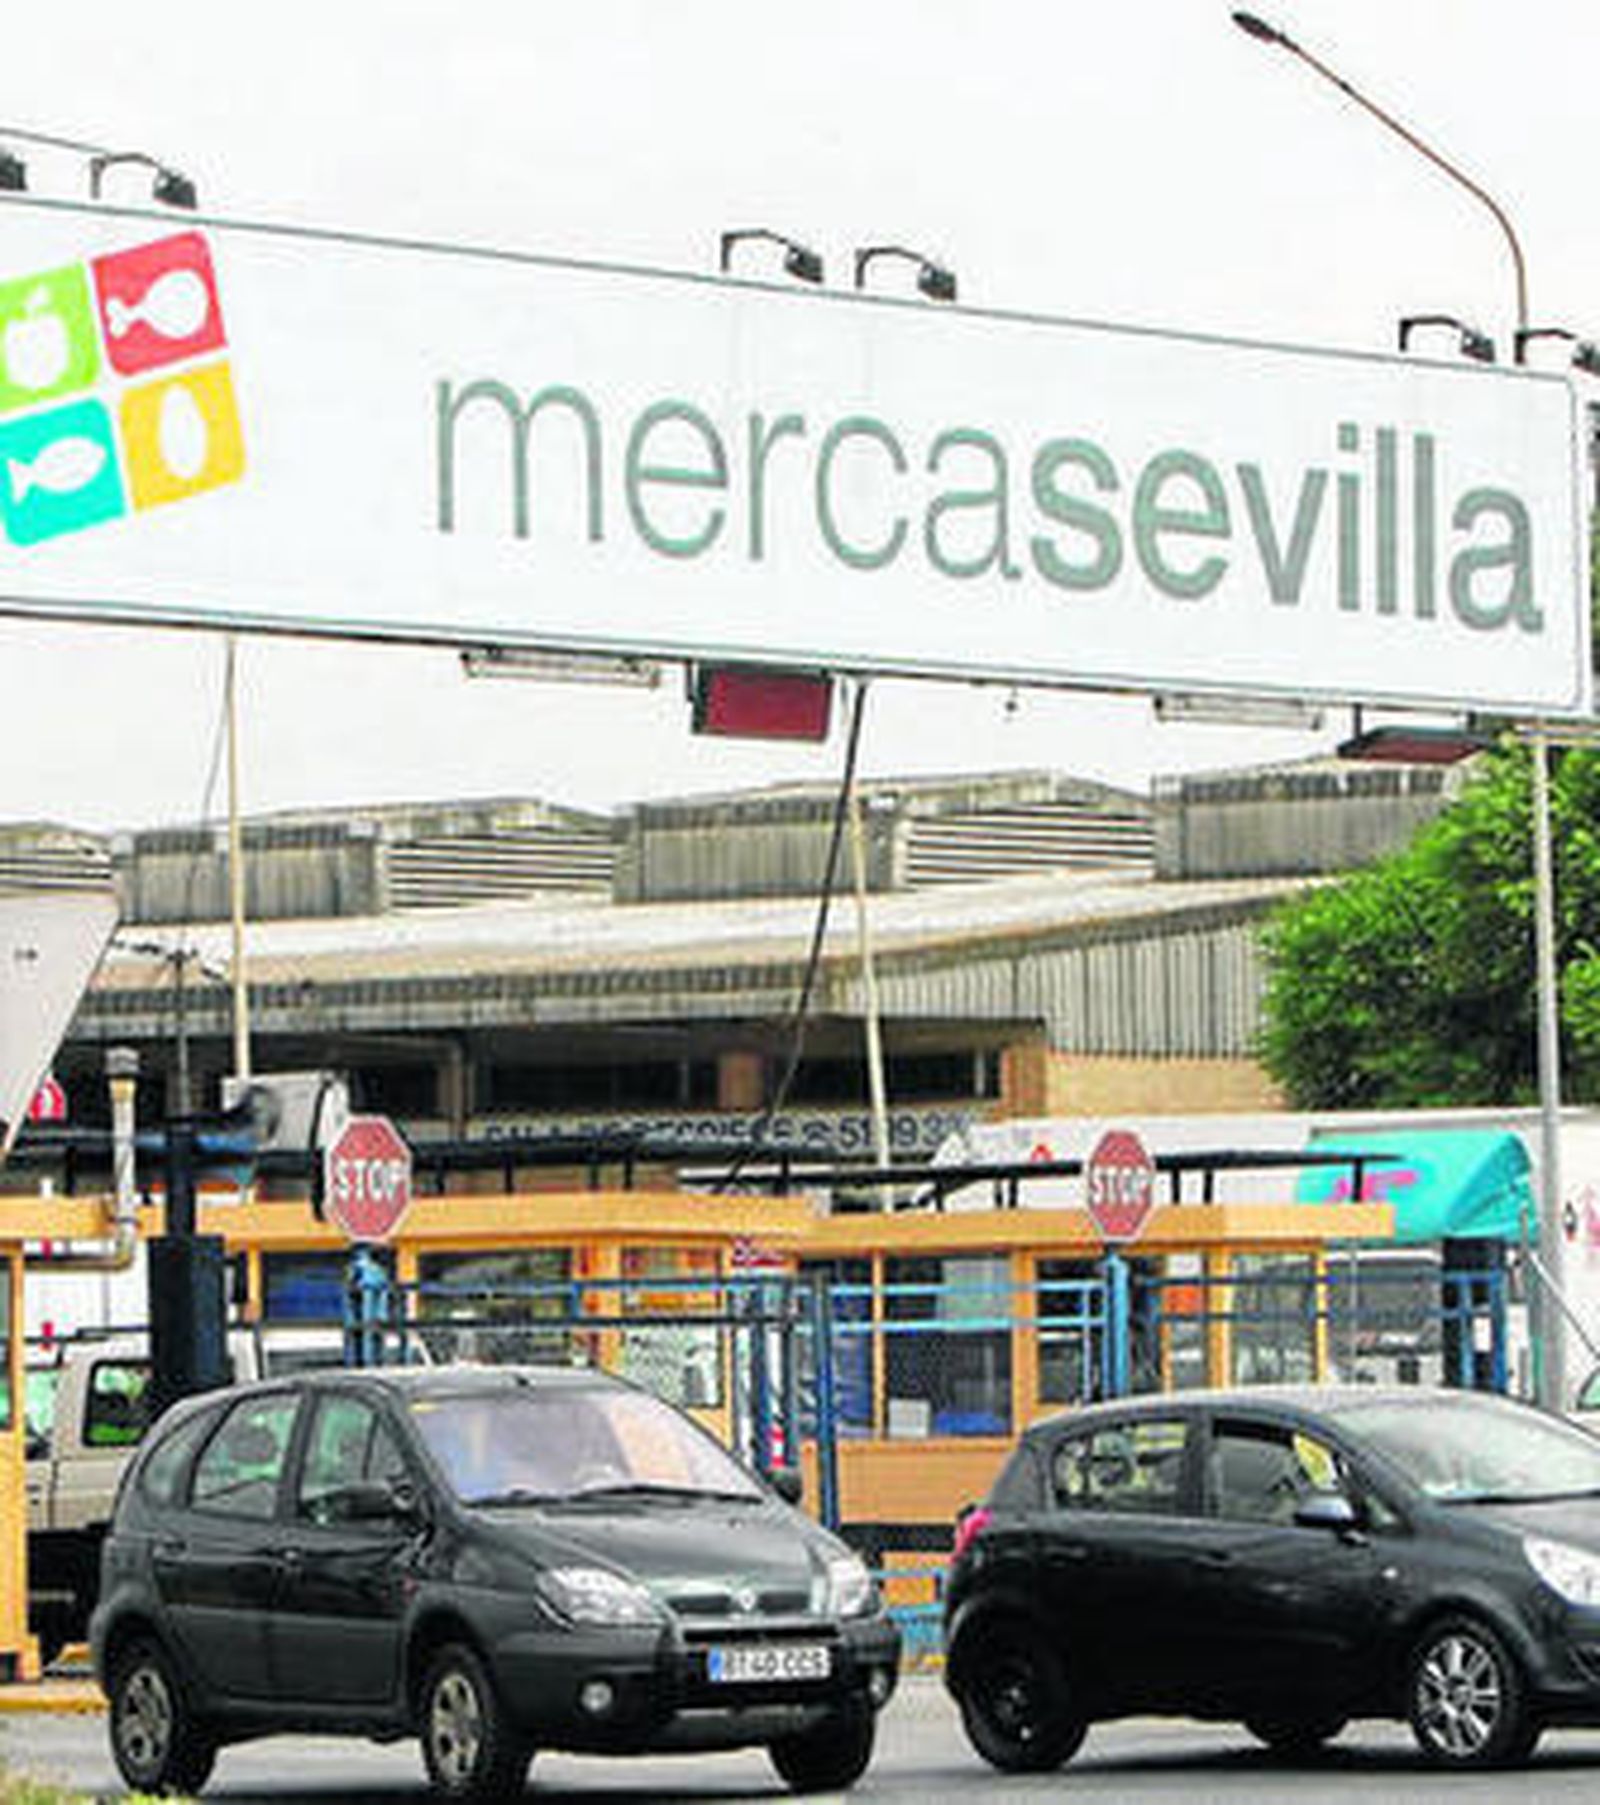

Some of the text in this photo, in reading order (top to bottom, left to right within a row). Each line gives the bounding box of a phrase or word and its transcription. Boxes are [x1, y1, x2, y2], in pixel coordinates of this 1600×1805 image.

[435, 376, 1543, 633] mercasevilla
[335, 1159, 408, 1201] STOP
[1091, 1166, 1152, 1205] STOP
